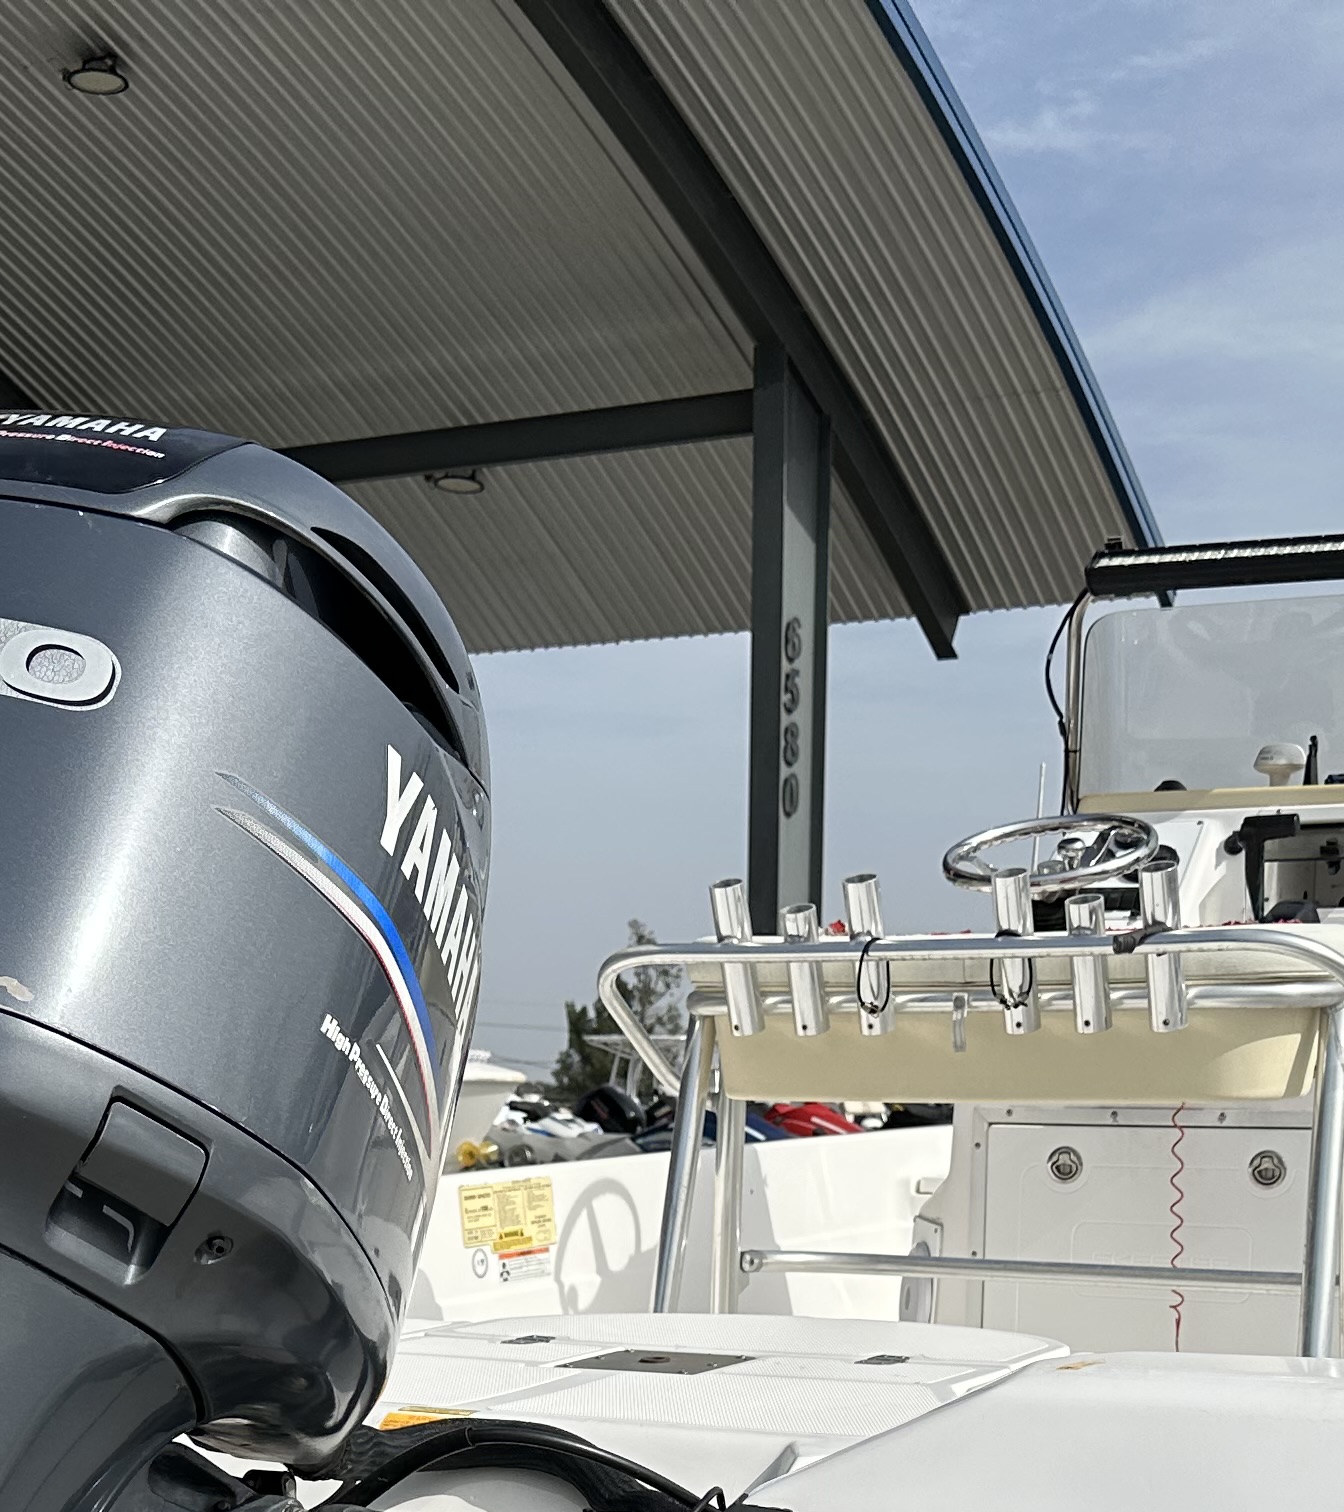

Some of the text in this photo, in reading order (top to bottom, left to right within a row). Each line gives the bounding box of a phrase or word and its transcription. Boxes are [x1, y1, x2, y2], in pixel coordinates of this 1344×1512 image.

[2, 413, 167, 442] YAMAHA
[56, 434, 102, 446] Direct
[102, 440, 166, 459] Injection
[782, 616, 803, 818] 6580
[380, 744, 479, 1037] YAMAHA
[319, 1013, 352, 1055] High
[348, 1042, 382, 1106] Pressure
[379, 1093, 398, 1140] Direct
